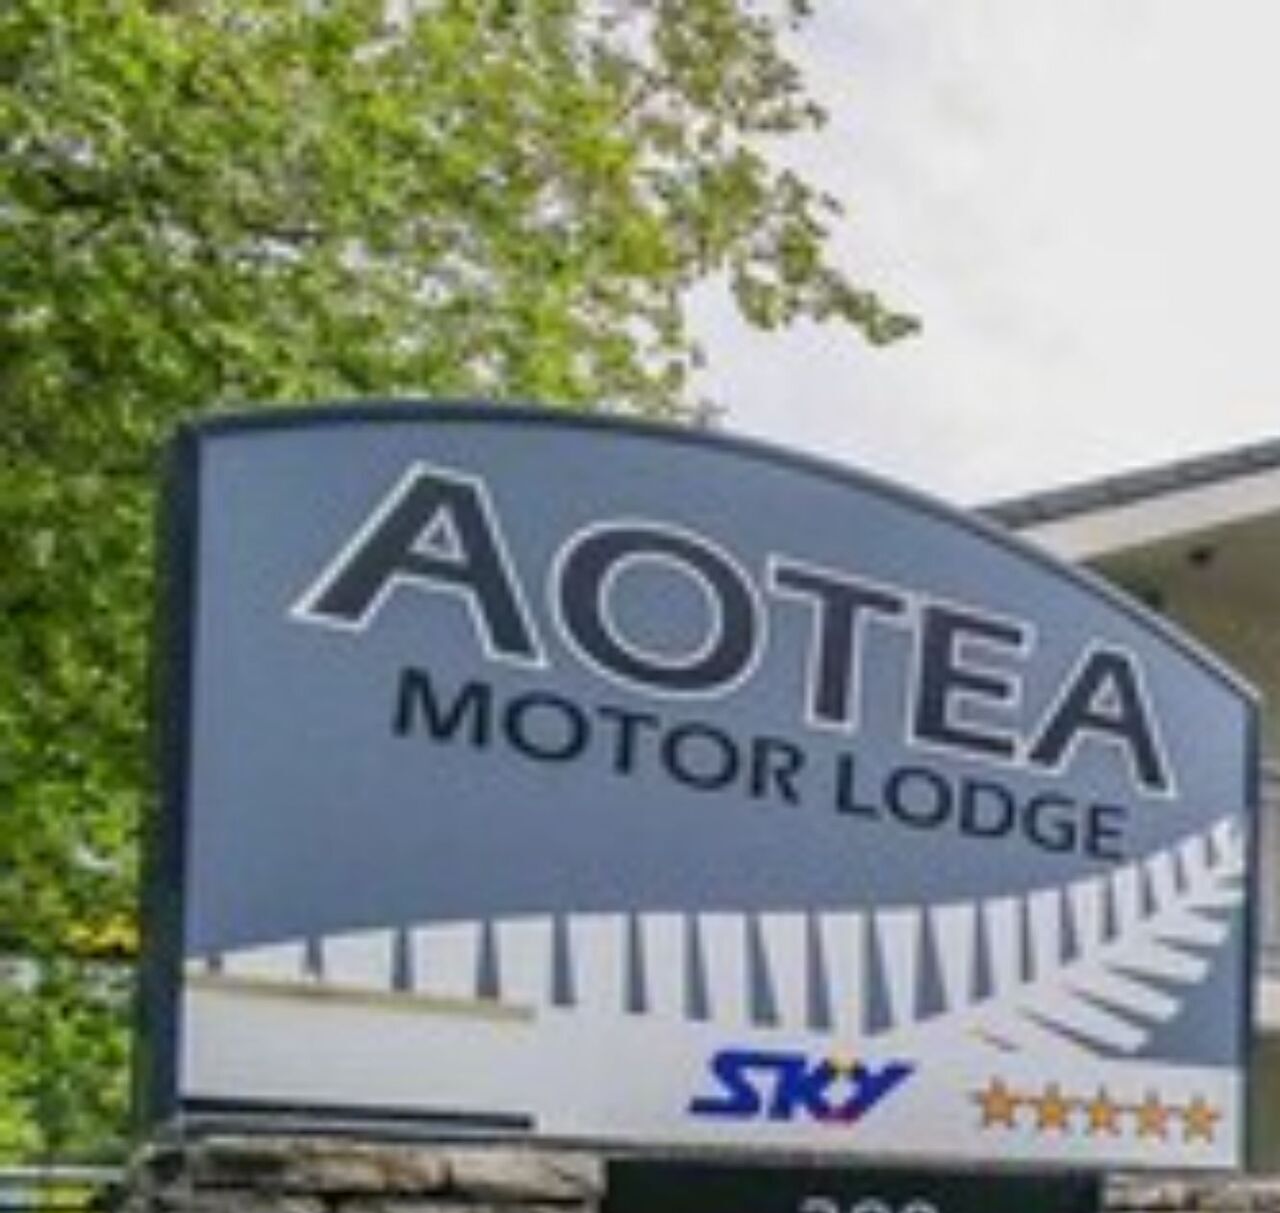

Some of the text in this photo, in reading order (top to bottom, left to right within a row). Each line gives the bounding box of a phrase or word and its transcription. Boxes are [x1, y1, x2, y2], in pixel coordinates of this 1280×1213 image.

[292, 460, 1176, 796] AOTEA
[394, 668, 1128, 860] MOTOR LODGE
[688, 1048, 915, 1124] SKY
